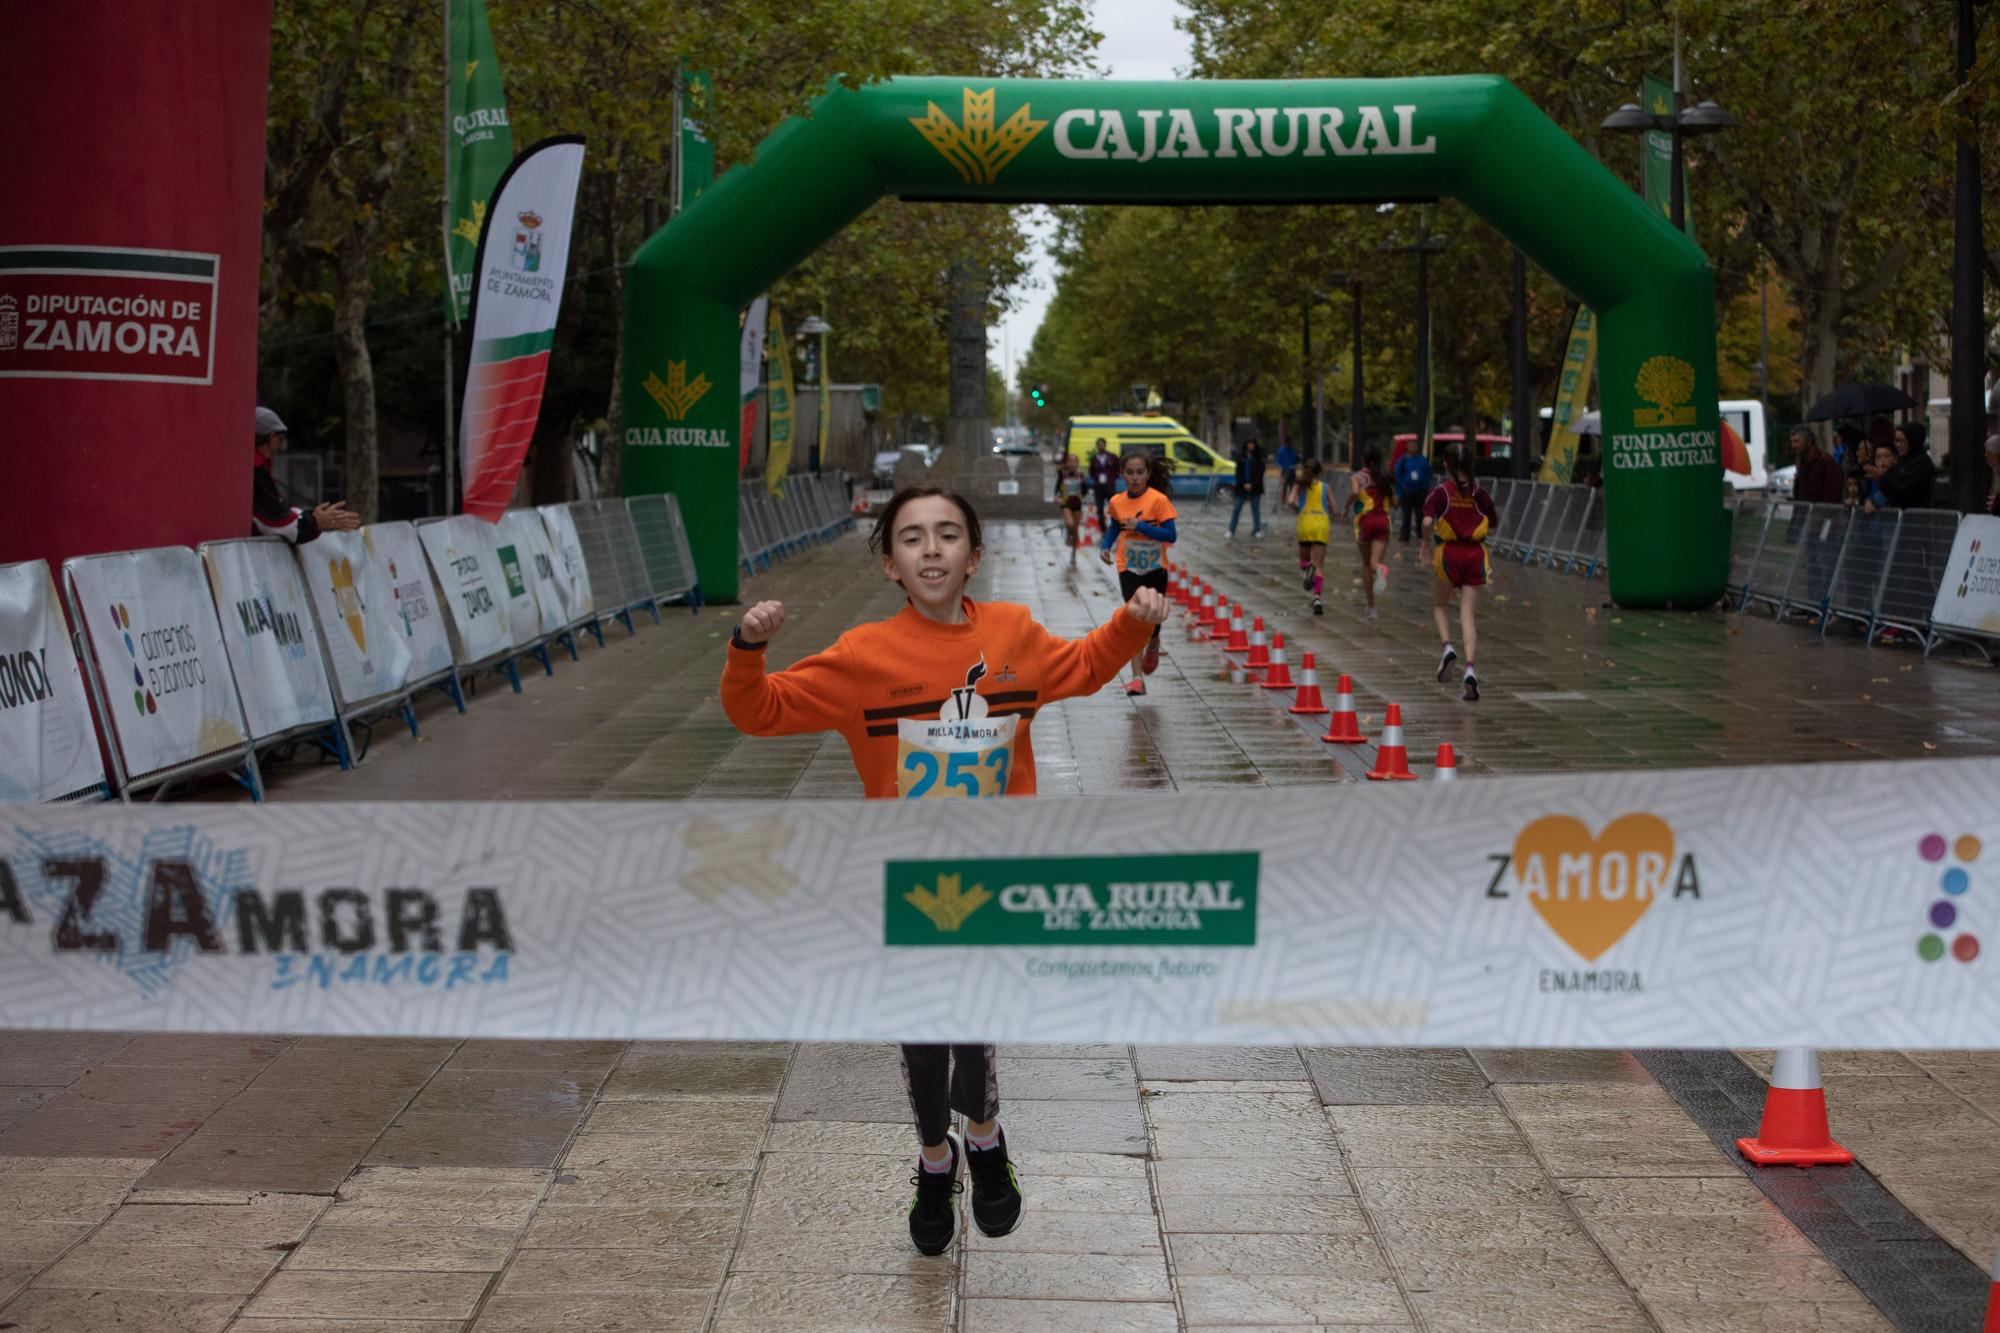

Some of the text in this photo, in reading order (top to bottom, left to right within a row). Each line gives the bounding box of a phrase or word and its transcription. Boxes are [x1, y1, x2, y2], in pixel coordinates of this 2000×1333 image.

[1053, 105, 1437, 163] CAJA RURAL
[487, 277, 501, 295] DE
[503, 282, 552, 304] ZAMORA
[489, 267, 554, 290] AYUNTAMIENTO
[26, 294, 201, 320] DIPUTACIÓN DE
[23, 319, 201, 357] ZAMORA
[625, 427, 731, 447] CAJA RURAL
[1612, 430, 1716, 452] FUNDACION
[1612, 448, 1717, 469] CAJA RURAL
[1127, 548, 1160, 569] 262
[904, 747, 1009, 798] 253
[1485, 850, 1701, 901] ZAMORA
[998, 880, 1245, 913] CAJA RURAL
[1042, 909, 1202, 931] DE ZAMORA
[1024, 957, 1152, 979] Compartimos
[1538, 968, 1643, 993] ENAMORA
